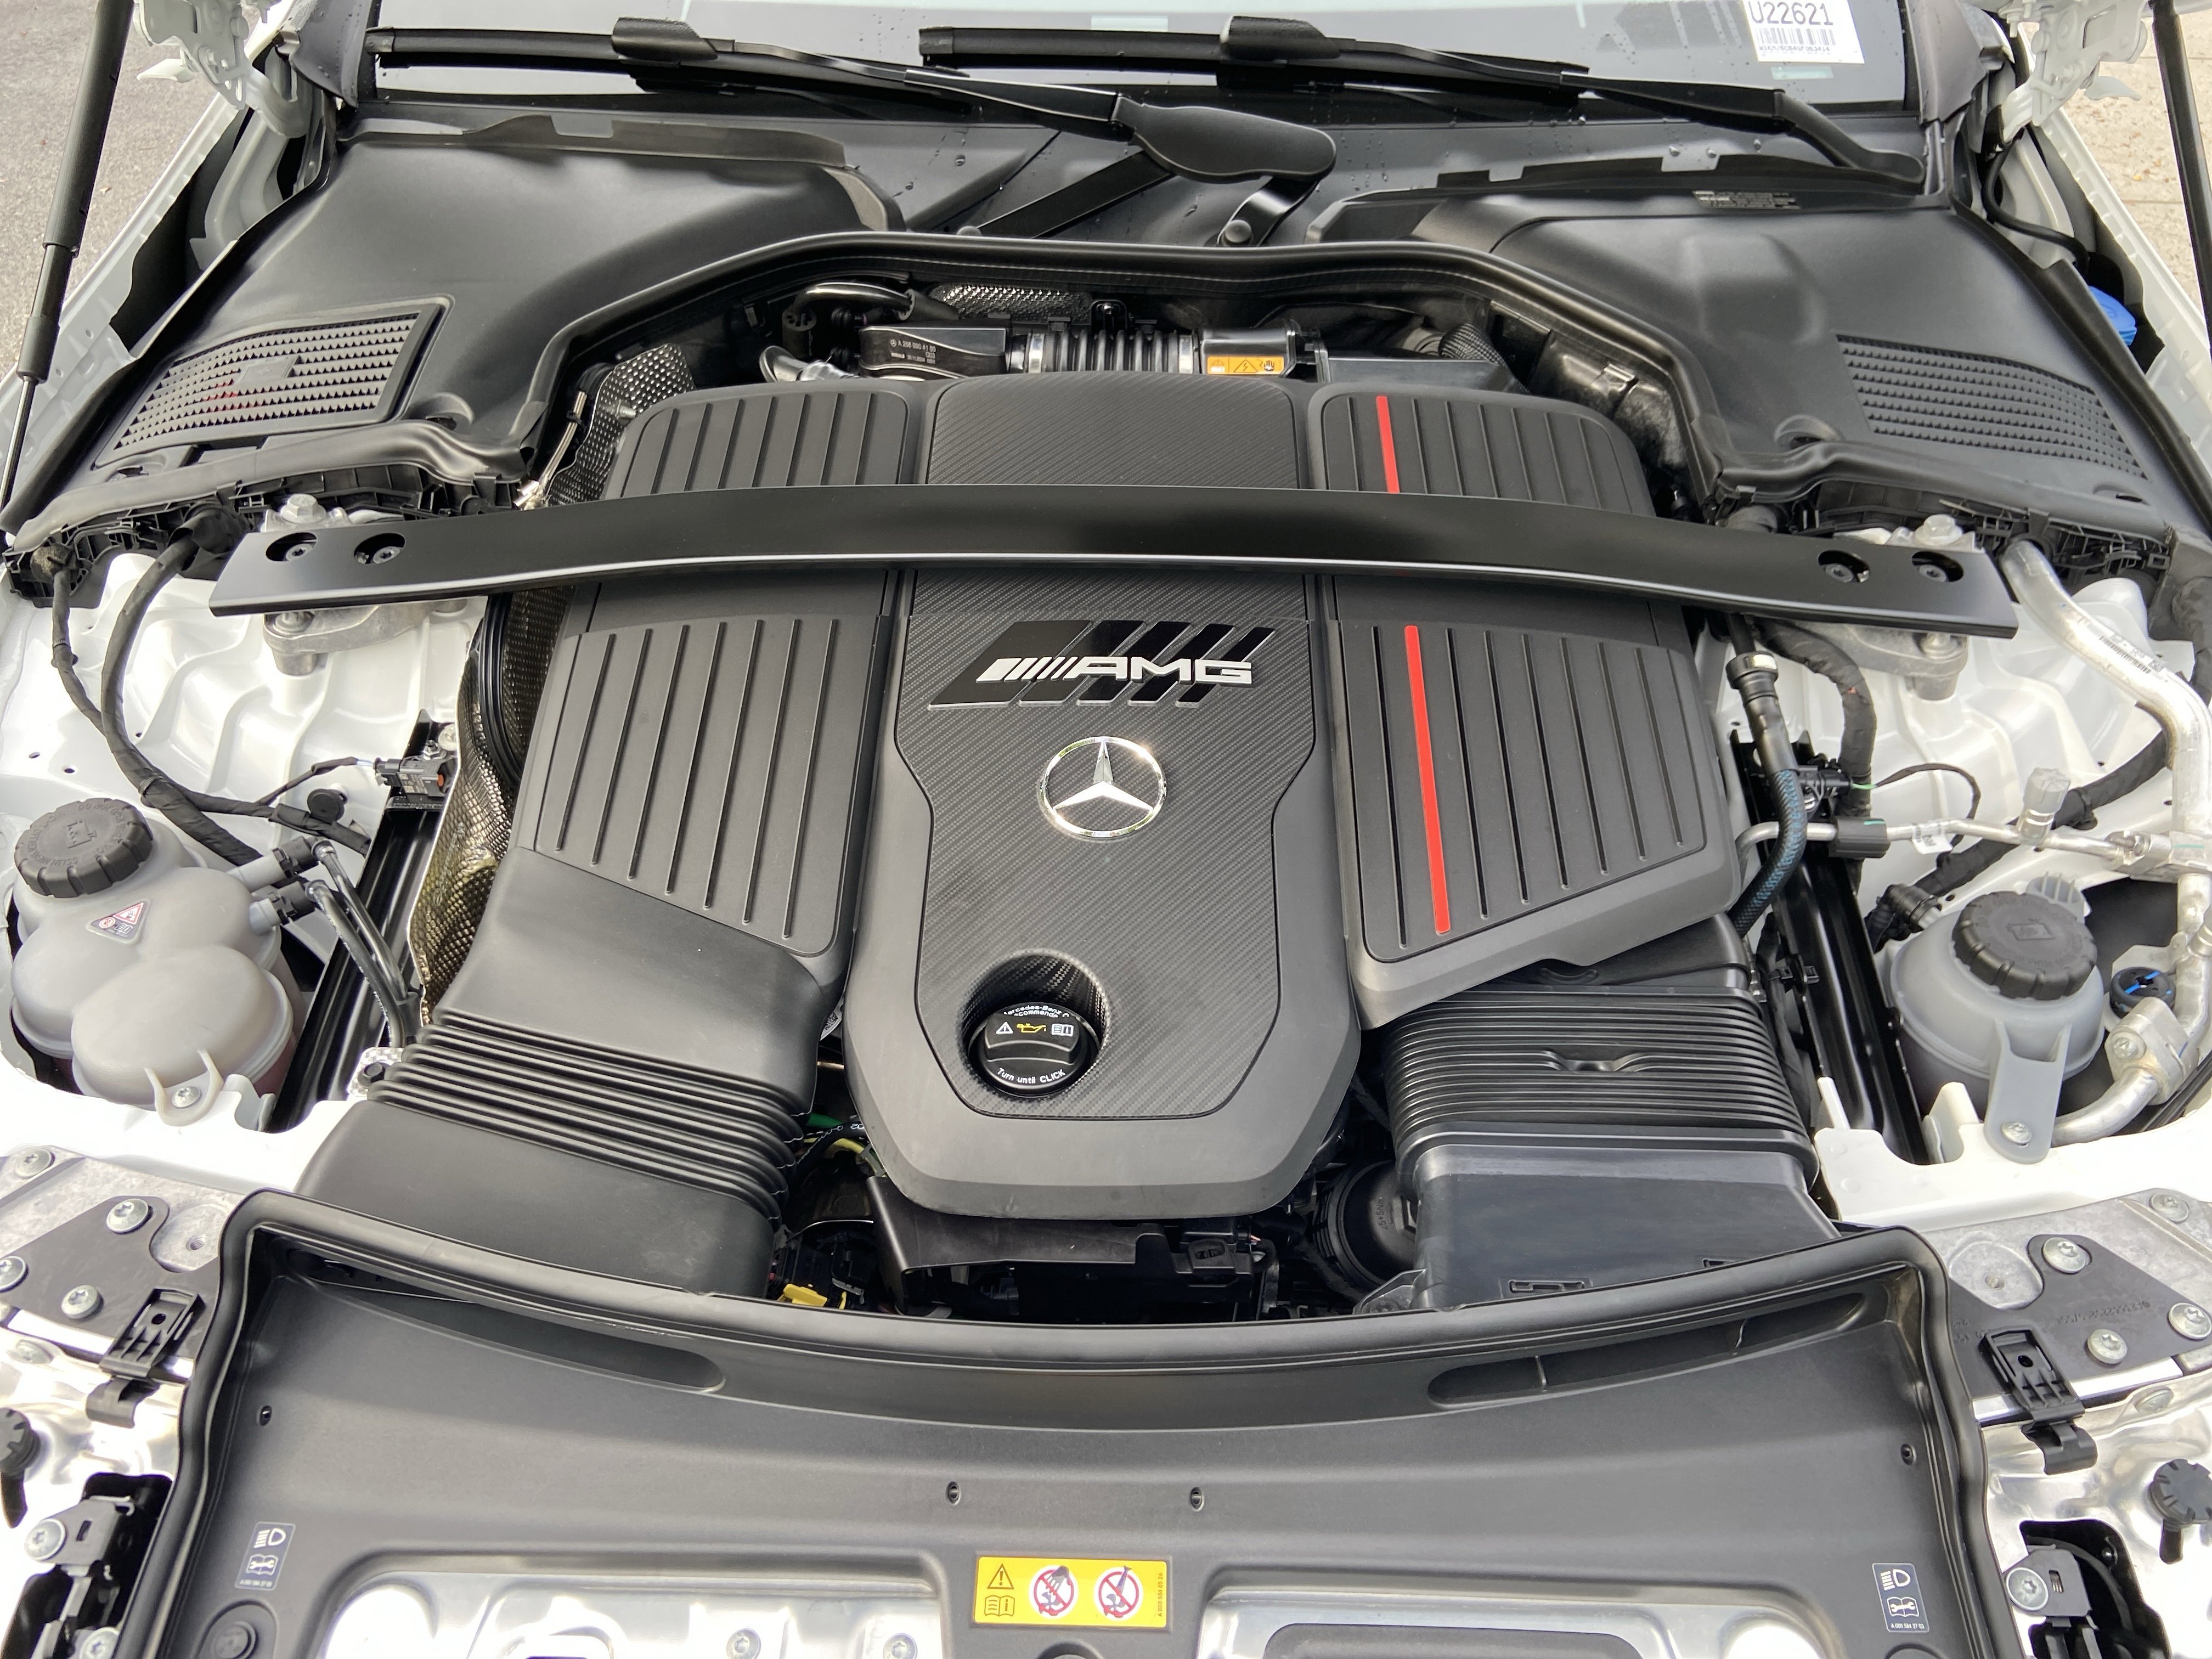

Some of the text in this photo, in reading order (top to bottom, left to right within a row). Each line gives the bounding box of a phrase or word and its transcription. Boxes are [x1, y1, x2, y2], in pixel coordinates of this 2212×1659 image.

[1748, 1, 1833, 25] U22621
[1063, 656, 1252, 685] AMG
[997, 1067, 1014, 1081] Turn
[1040, 1069, 1066, 1083] CLICK
